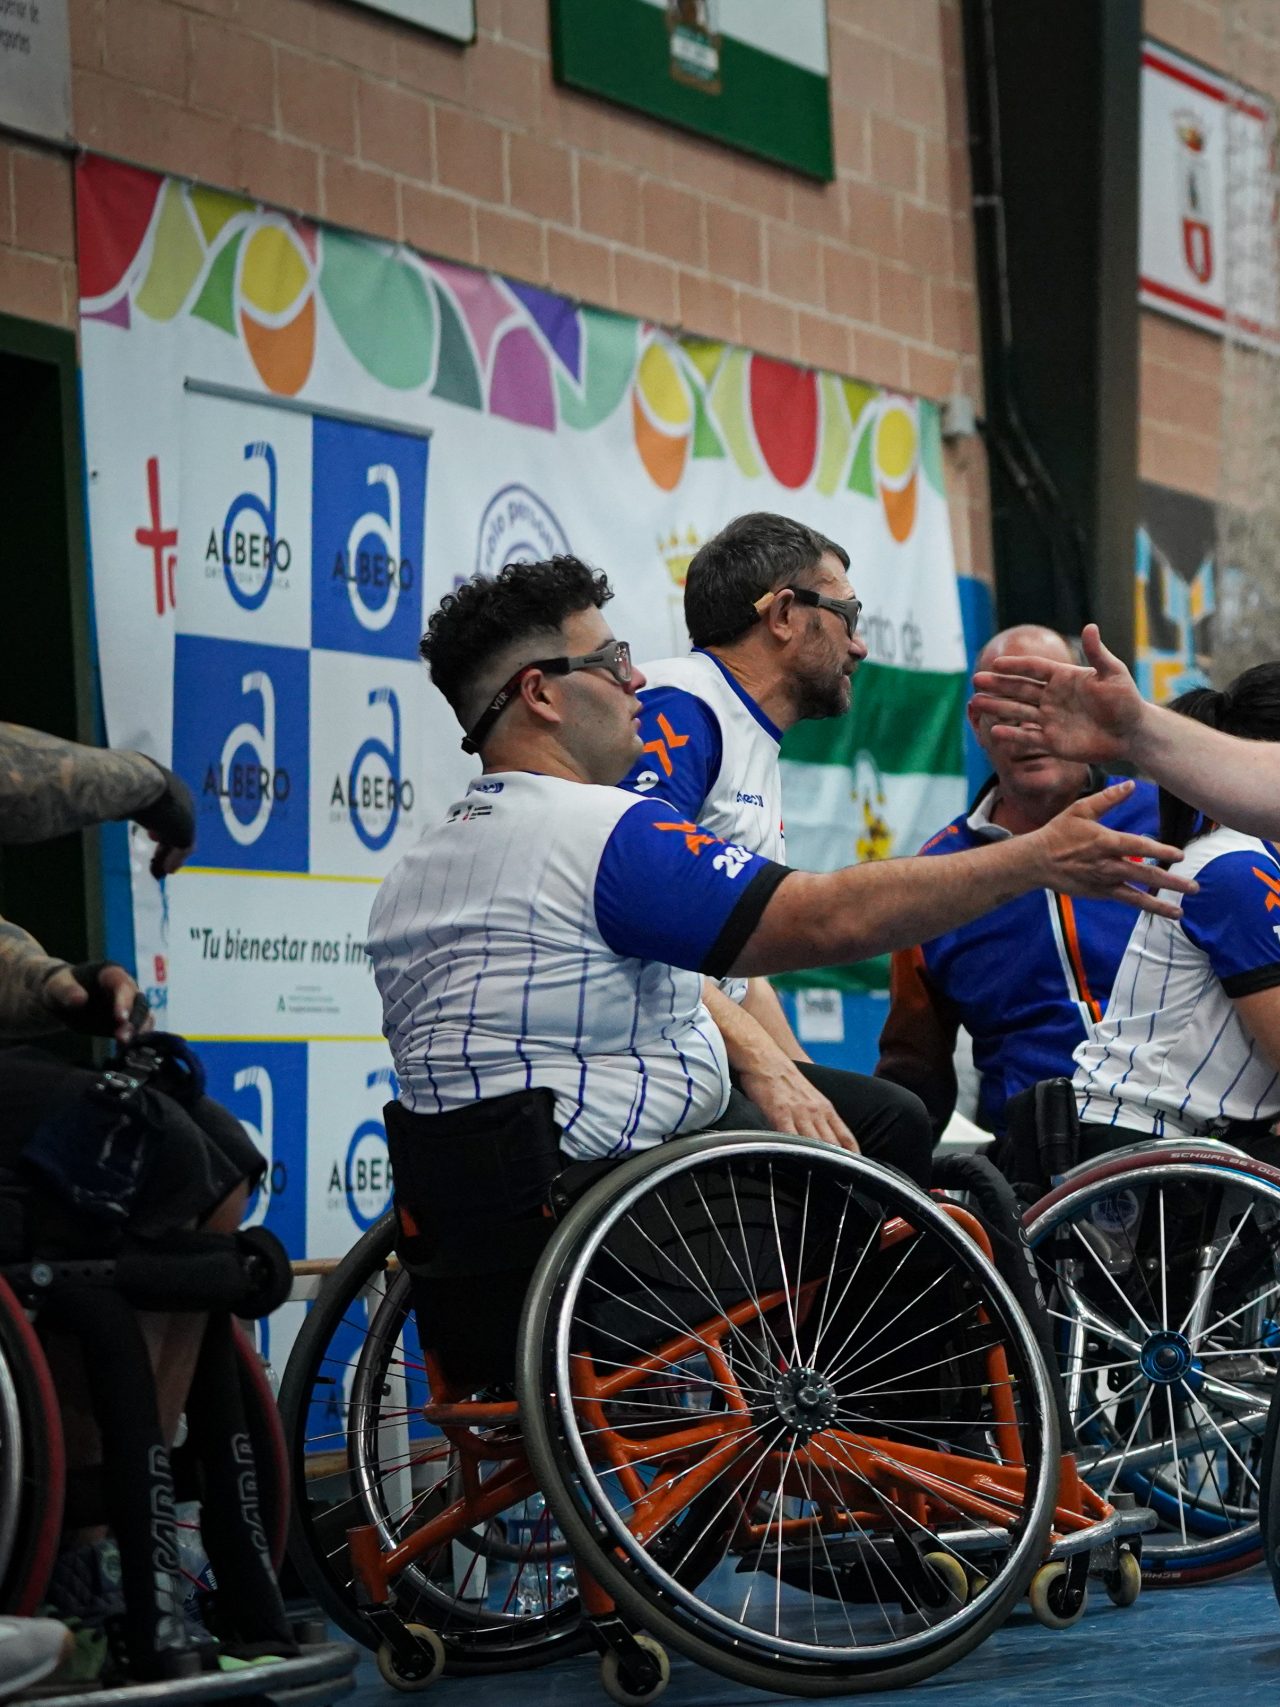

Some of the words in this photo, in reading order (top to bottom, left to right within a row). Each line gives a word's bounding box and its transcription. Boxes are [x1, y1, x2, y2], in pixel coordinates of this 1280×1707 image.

[205, 527, 291, 572] ALBERO
[332, 550, 413, 592] ALBERO
[203, 763, 290, 802] ALBERO
[330, 773, 415, 813] ALBERO
[225, 929, 307, 962] bienestar
[312, 936, 339, 964] nos
